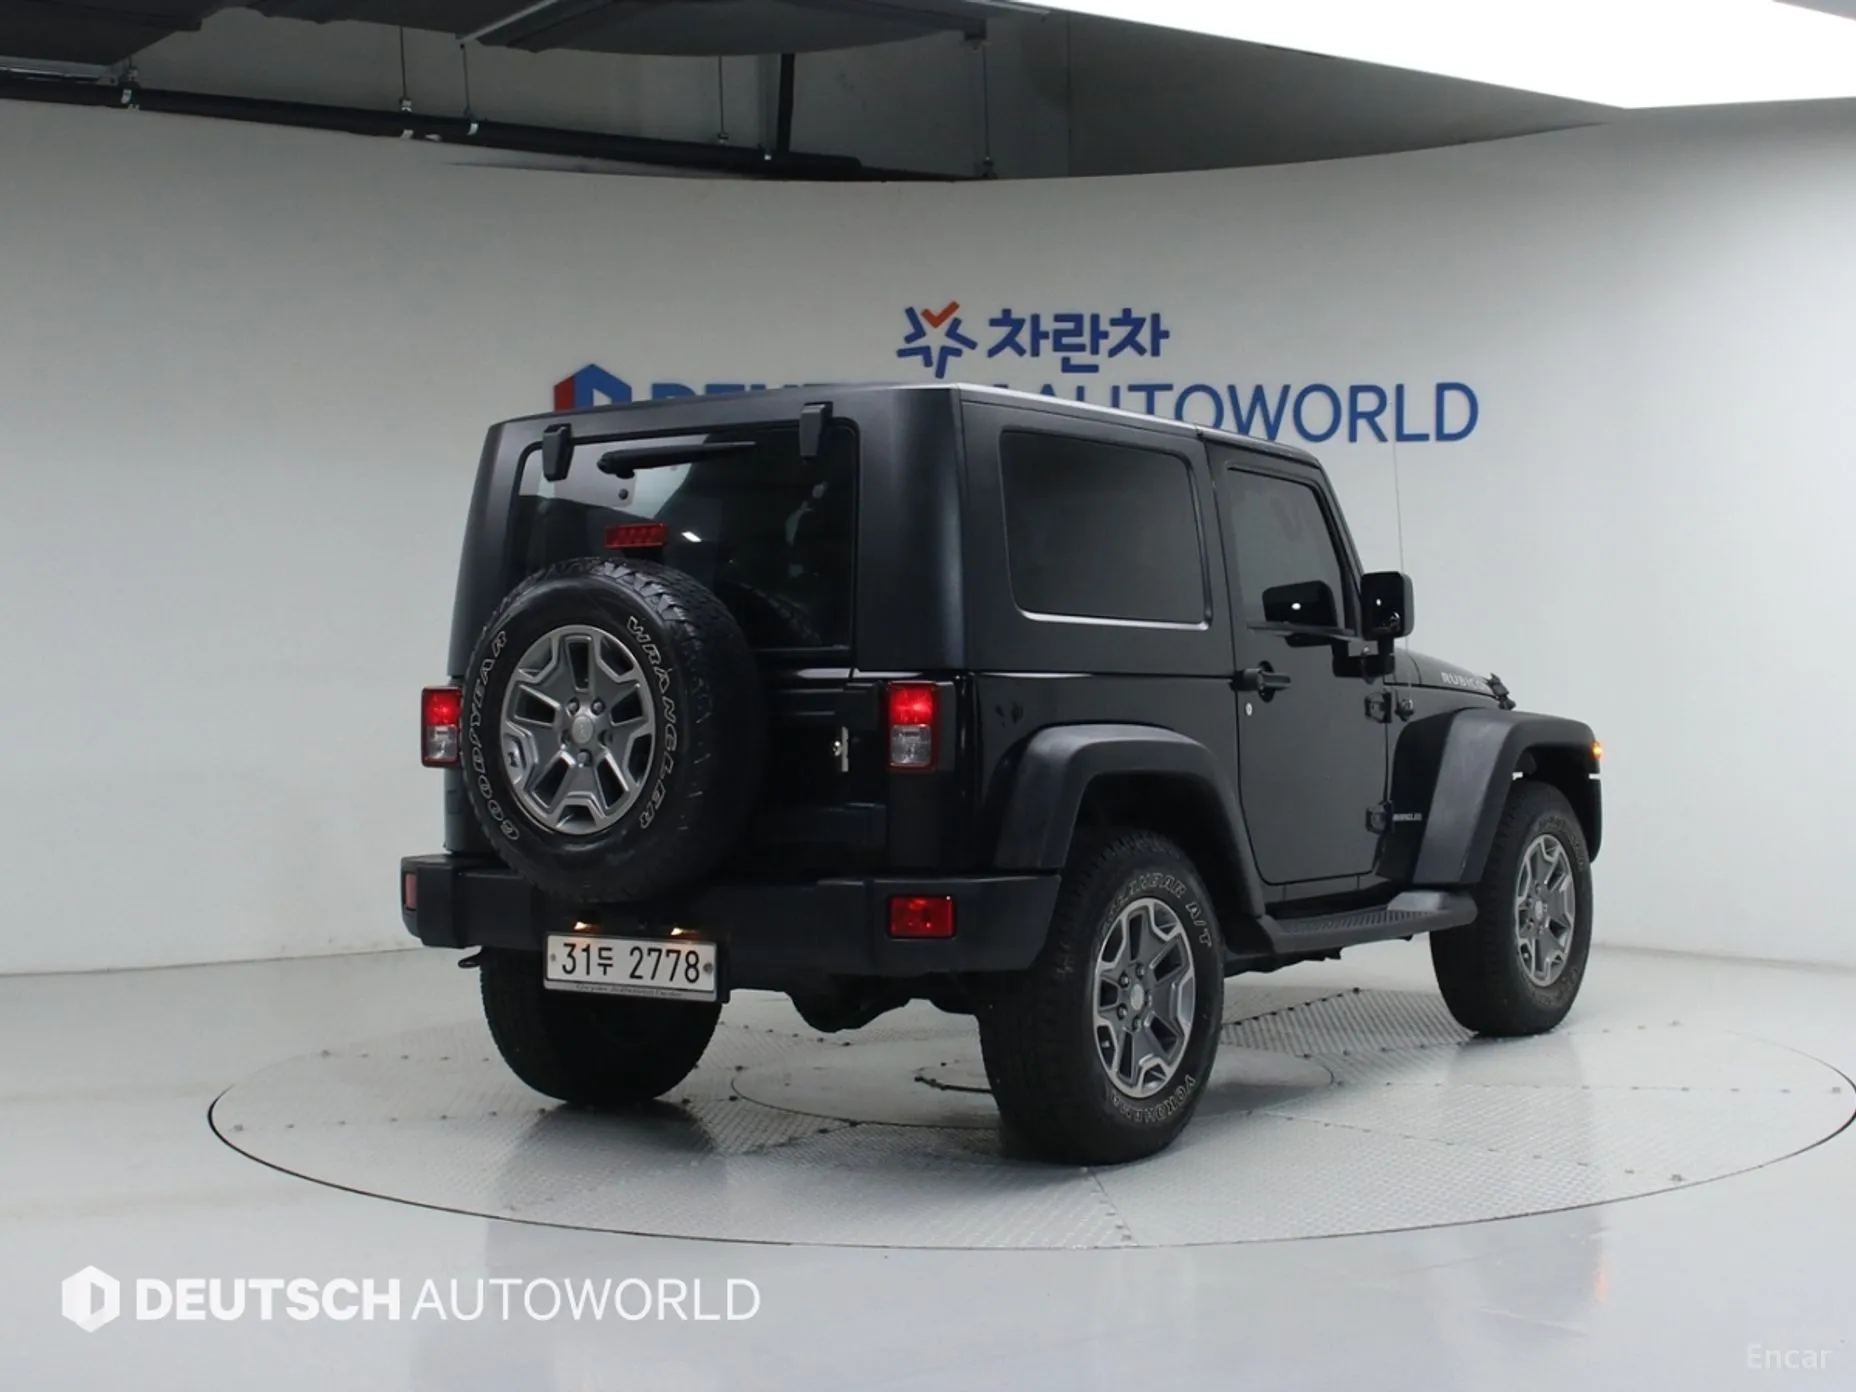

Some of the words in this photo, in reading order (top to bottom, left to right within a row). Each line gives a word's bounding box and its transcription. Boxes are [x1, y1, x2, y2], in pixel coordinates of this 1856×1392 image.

[988, 308, 1168, 374] 차란차
[1040, 381, 1479, 444] TOWORLD
[1441, 671, 1487, 691] RUBICO
[467, 630, 521, 841] GOODYEAR
[626, 615, 678, 829] WRANGLER
[562, 942, 614, 976] 31두
[629, 946, 700, 983] 2778
